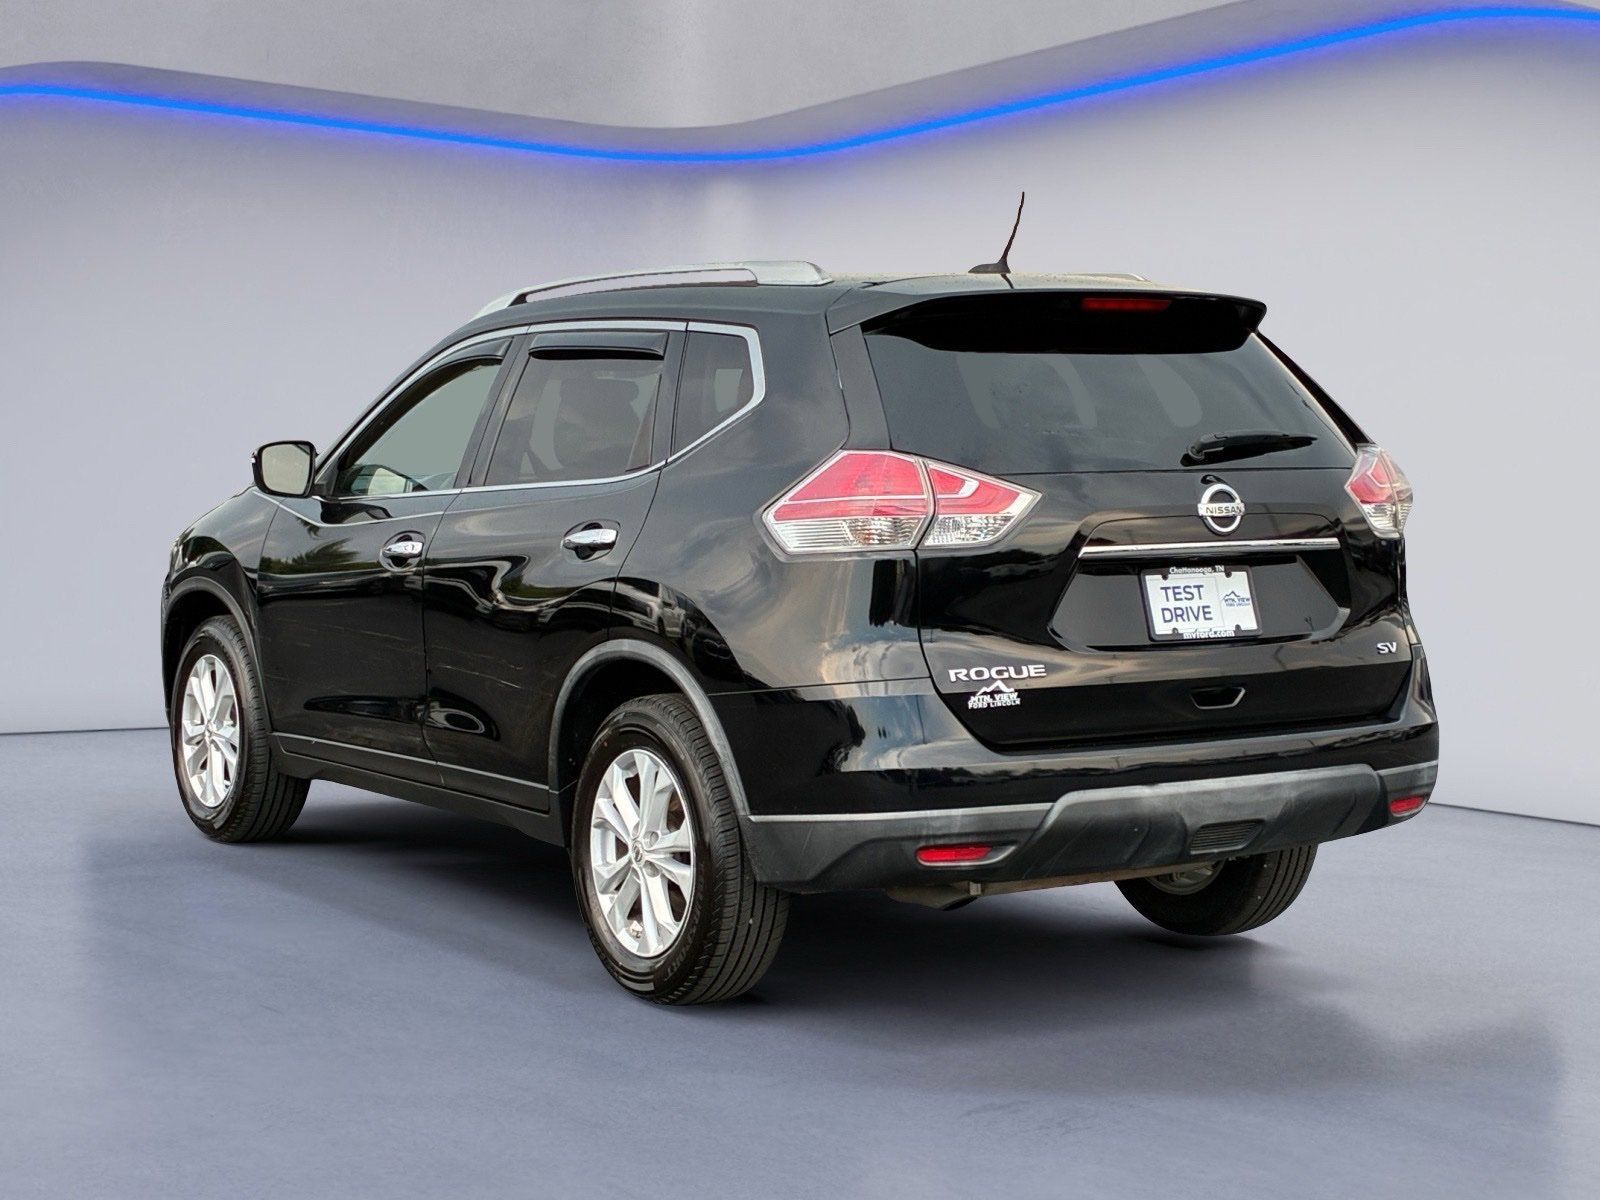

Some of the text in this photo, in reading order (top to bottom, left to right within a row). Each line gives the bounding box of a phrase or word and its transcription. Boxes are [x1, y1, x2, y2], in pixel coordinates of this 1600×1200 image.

[1205, 506, 1243, 514] NISSAN
[1160, 585, 1203, 602] TEST
[1161, 605, 1213, 623] DRIVE
[1377, 641, 1397, 654] SV
[948, 664, 1047, 682] ROGUE
[994, 692, 1018, 701] VIEW
[968, 698, 1021, 709] FORD LINCOLN
